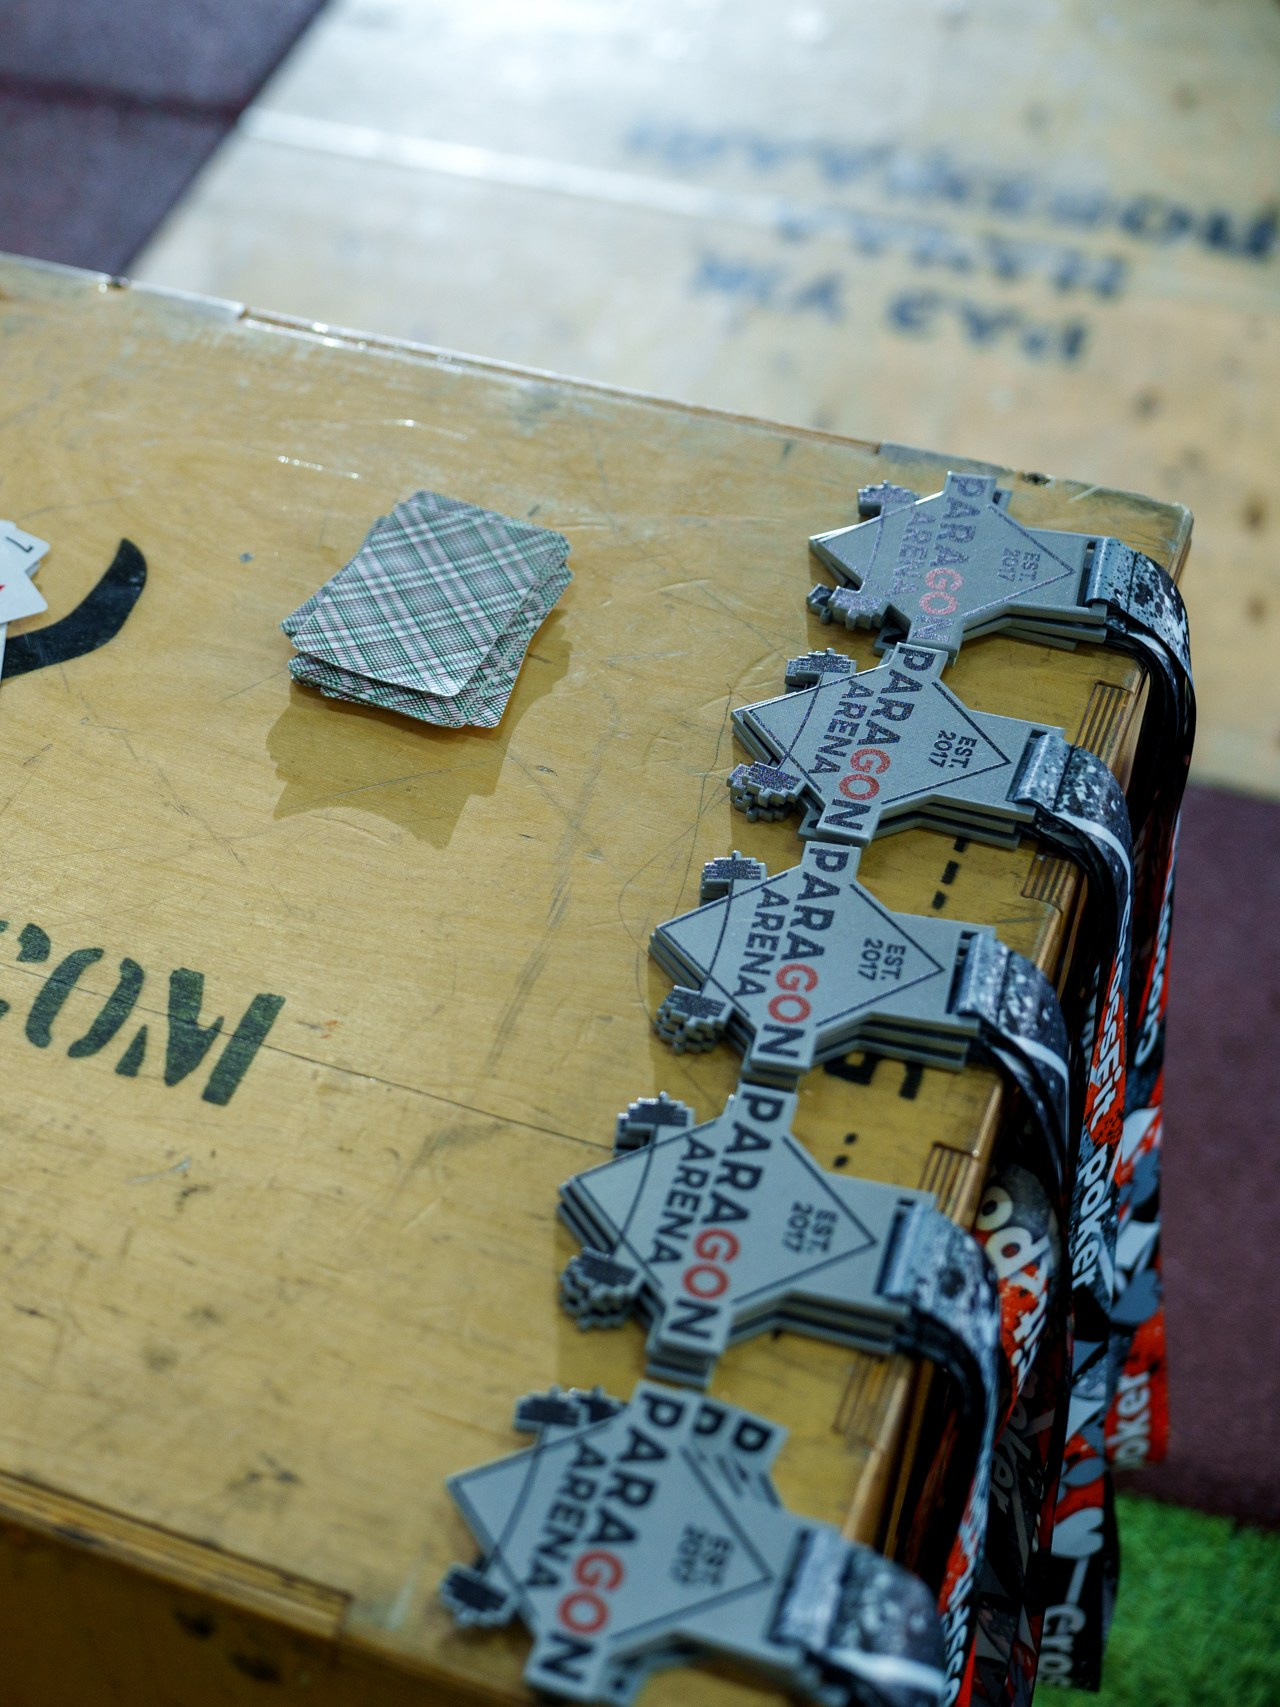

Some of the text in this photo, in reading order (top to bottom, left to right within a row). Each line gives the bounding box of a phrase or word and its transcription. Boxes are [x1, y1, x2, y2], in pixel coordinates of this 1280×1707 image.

[883, 506, 936, 596] ARENA
[912, 476, 986, 642] PARAGON
[997, 547, 1021, 582] 2017
[808, 679, 875, 774] ARENA
[823, 648, 937, 830] PARAGON
[927, 730, 957, 768] 2017
[948, 736, 978, 769] EST.
[733, 887, 789, 997] ARENA
[757, 847, 850, 1058] PARAGON
[858, 938, 884, 981] 2017
[880, 943, 906, 980] EST.
[647, 1133, 715, 1265] ARENA
[668, 1092, 786, 1340] PARAGON
[1072, 1142, 1112, 1290] poker
[526, 1438, 605, 1588] ARENA
[538, 1391, 687, 1682] PARAGON
